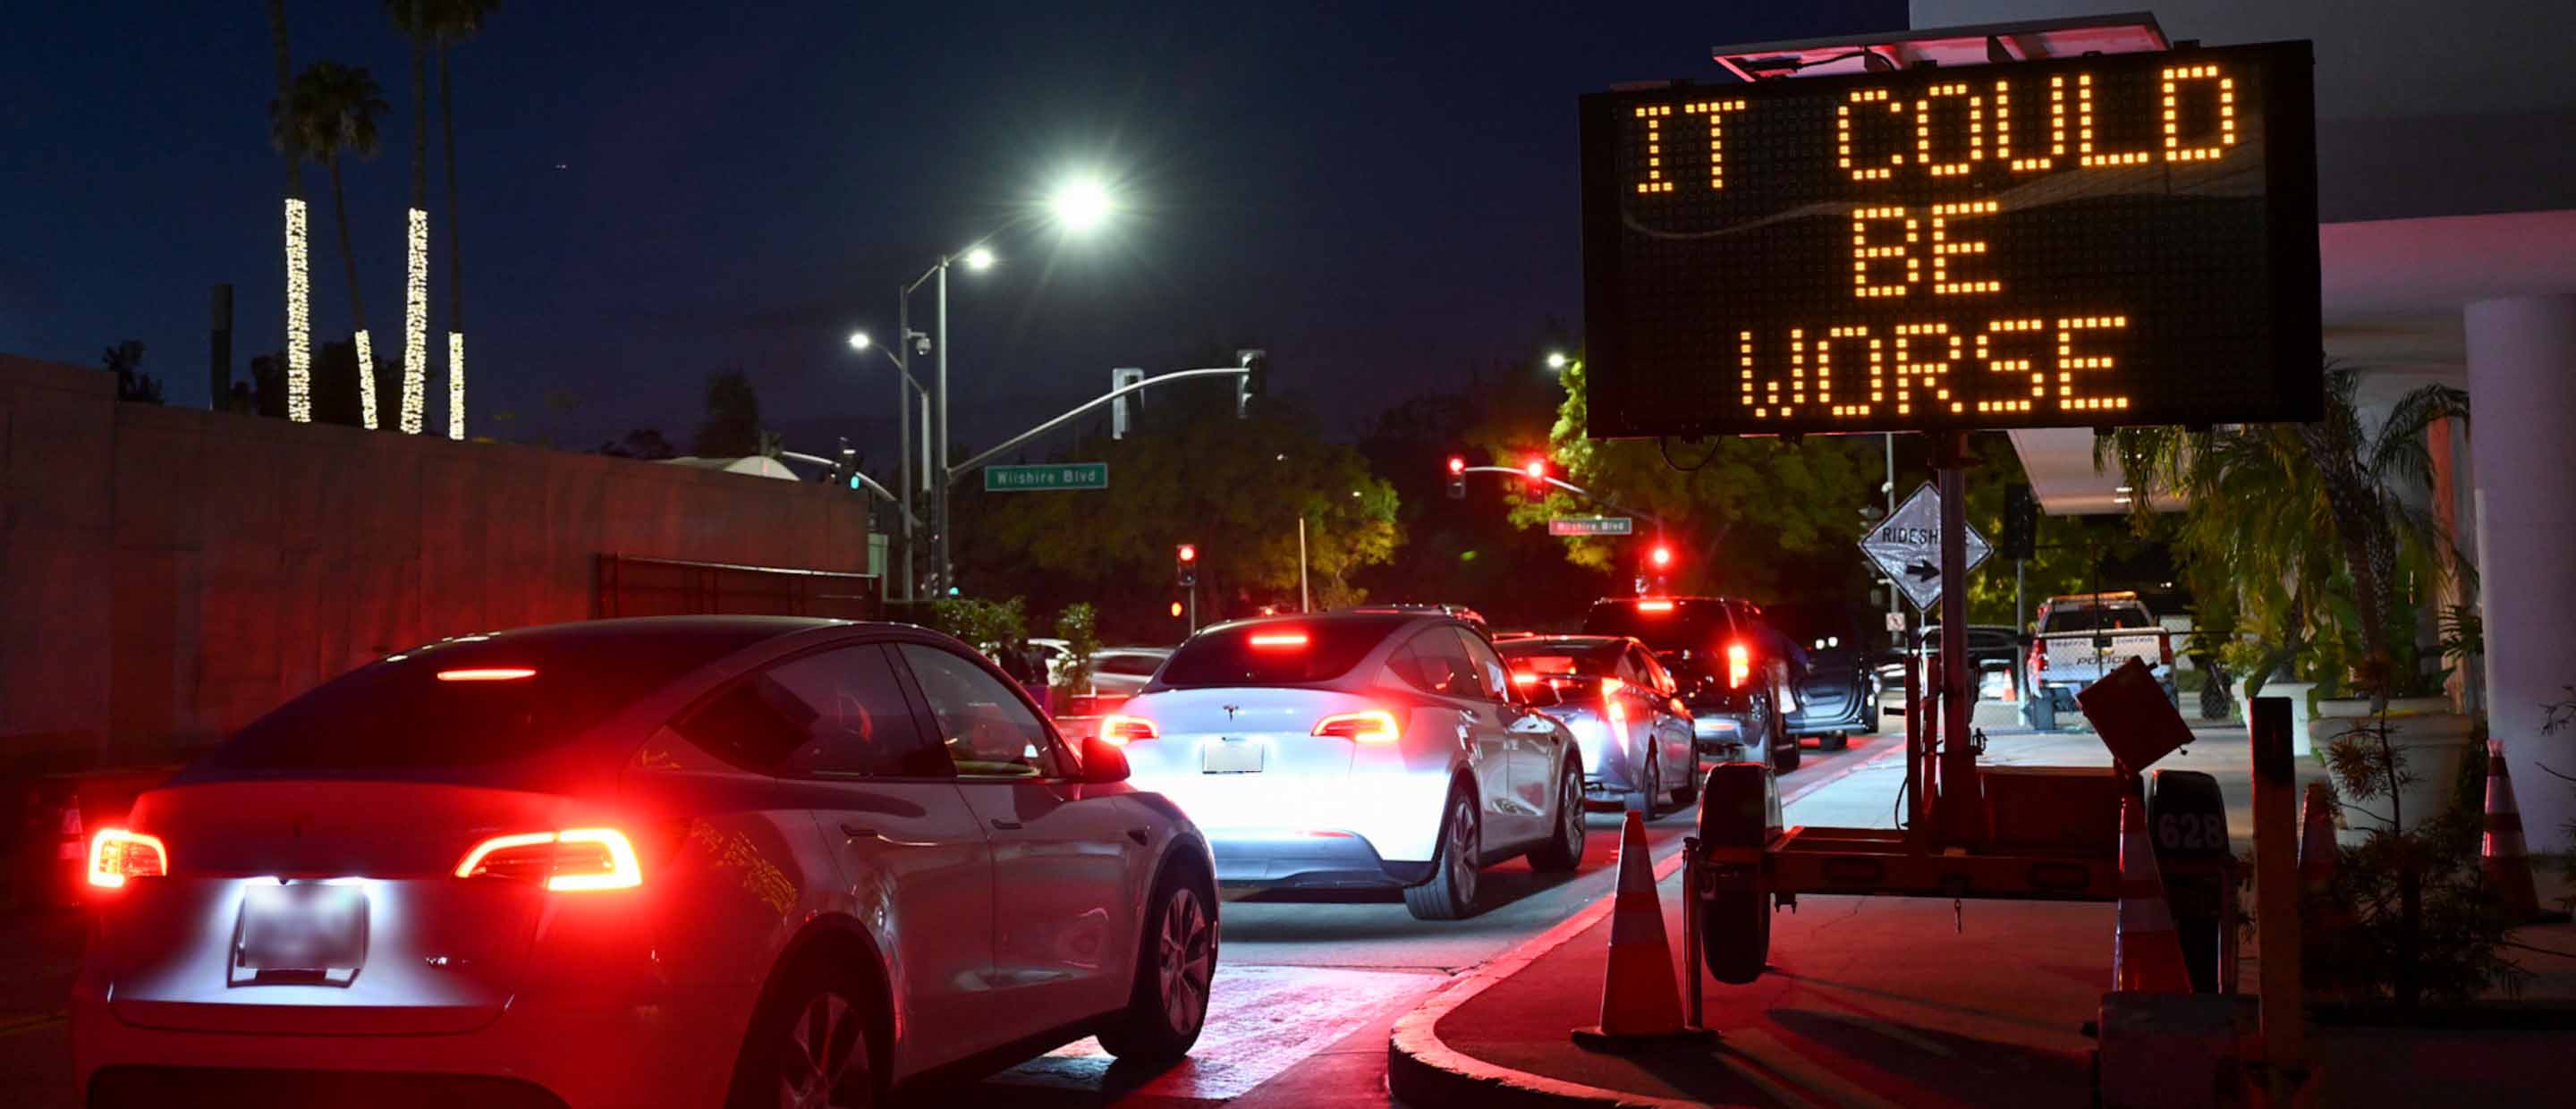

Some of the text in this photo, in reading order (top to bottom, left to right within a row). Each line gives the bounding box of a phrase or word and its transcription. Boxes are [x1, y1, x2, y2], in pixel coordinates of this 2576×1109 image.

[1635, 64, 2236, 193] IT COULD
[1852, 199, 2001, 298] BE
[1739, 316, 2129, 418] WORSE
[996, 469, 1096, 484] Wilshire Blvd
[1601, 521, 1624, 530] Blvd
[2157, 812, 2223, 849] 628
